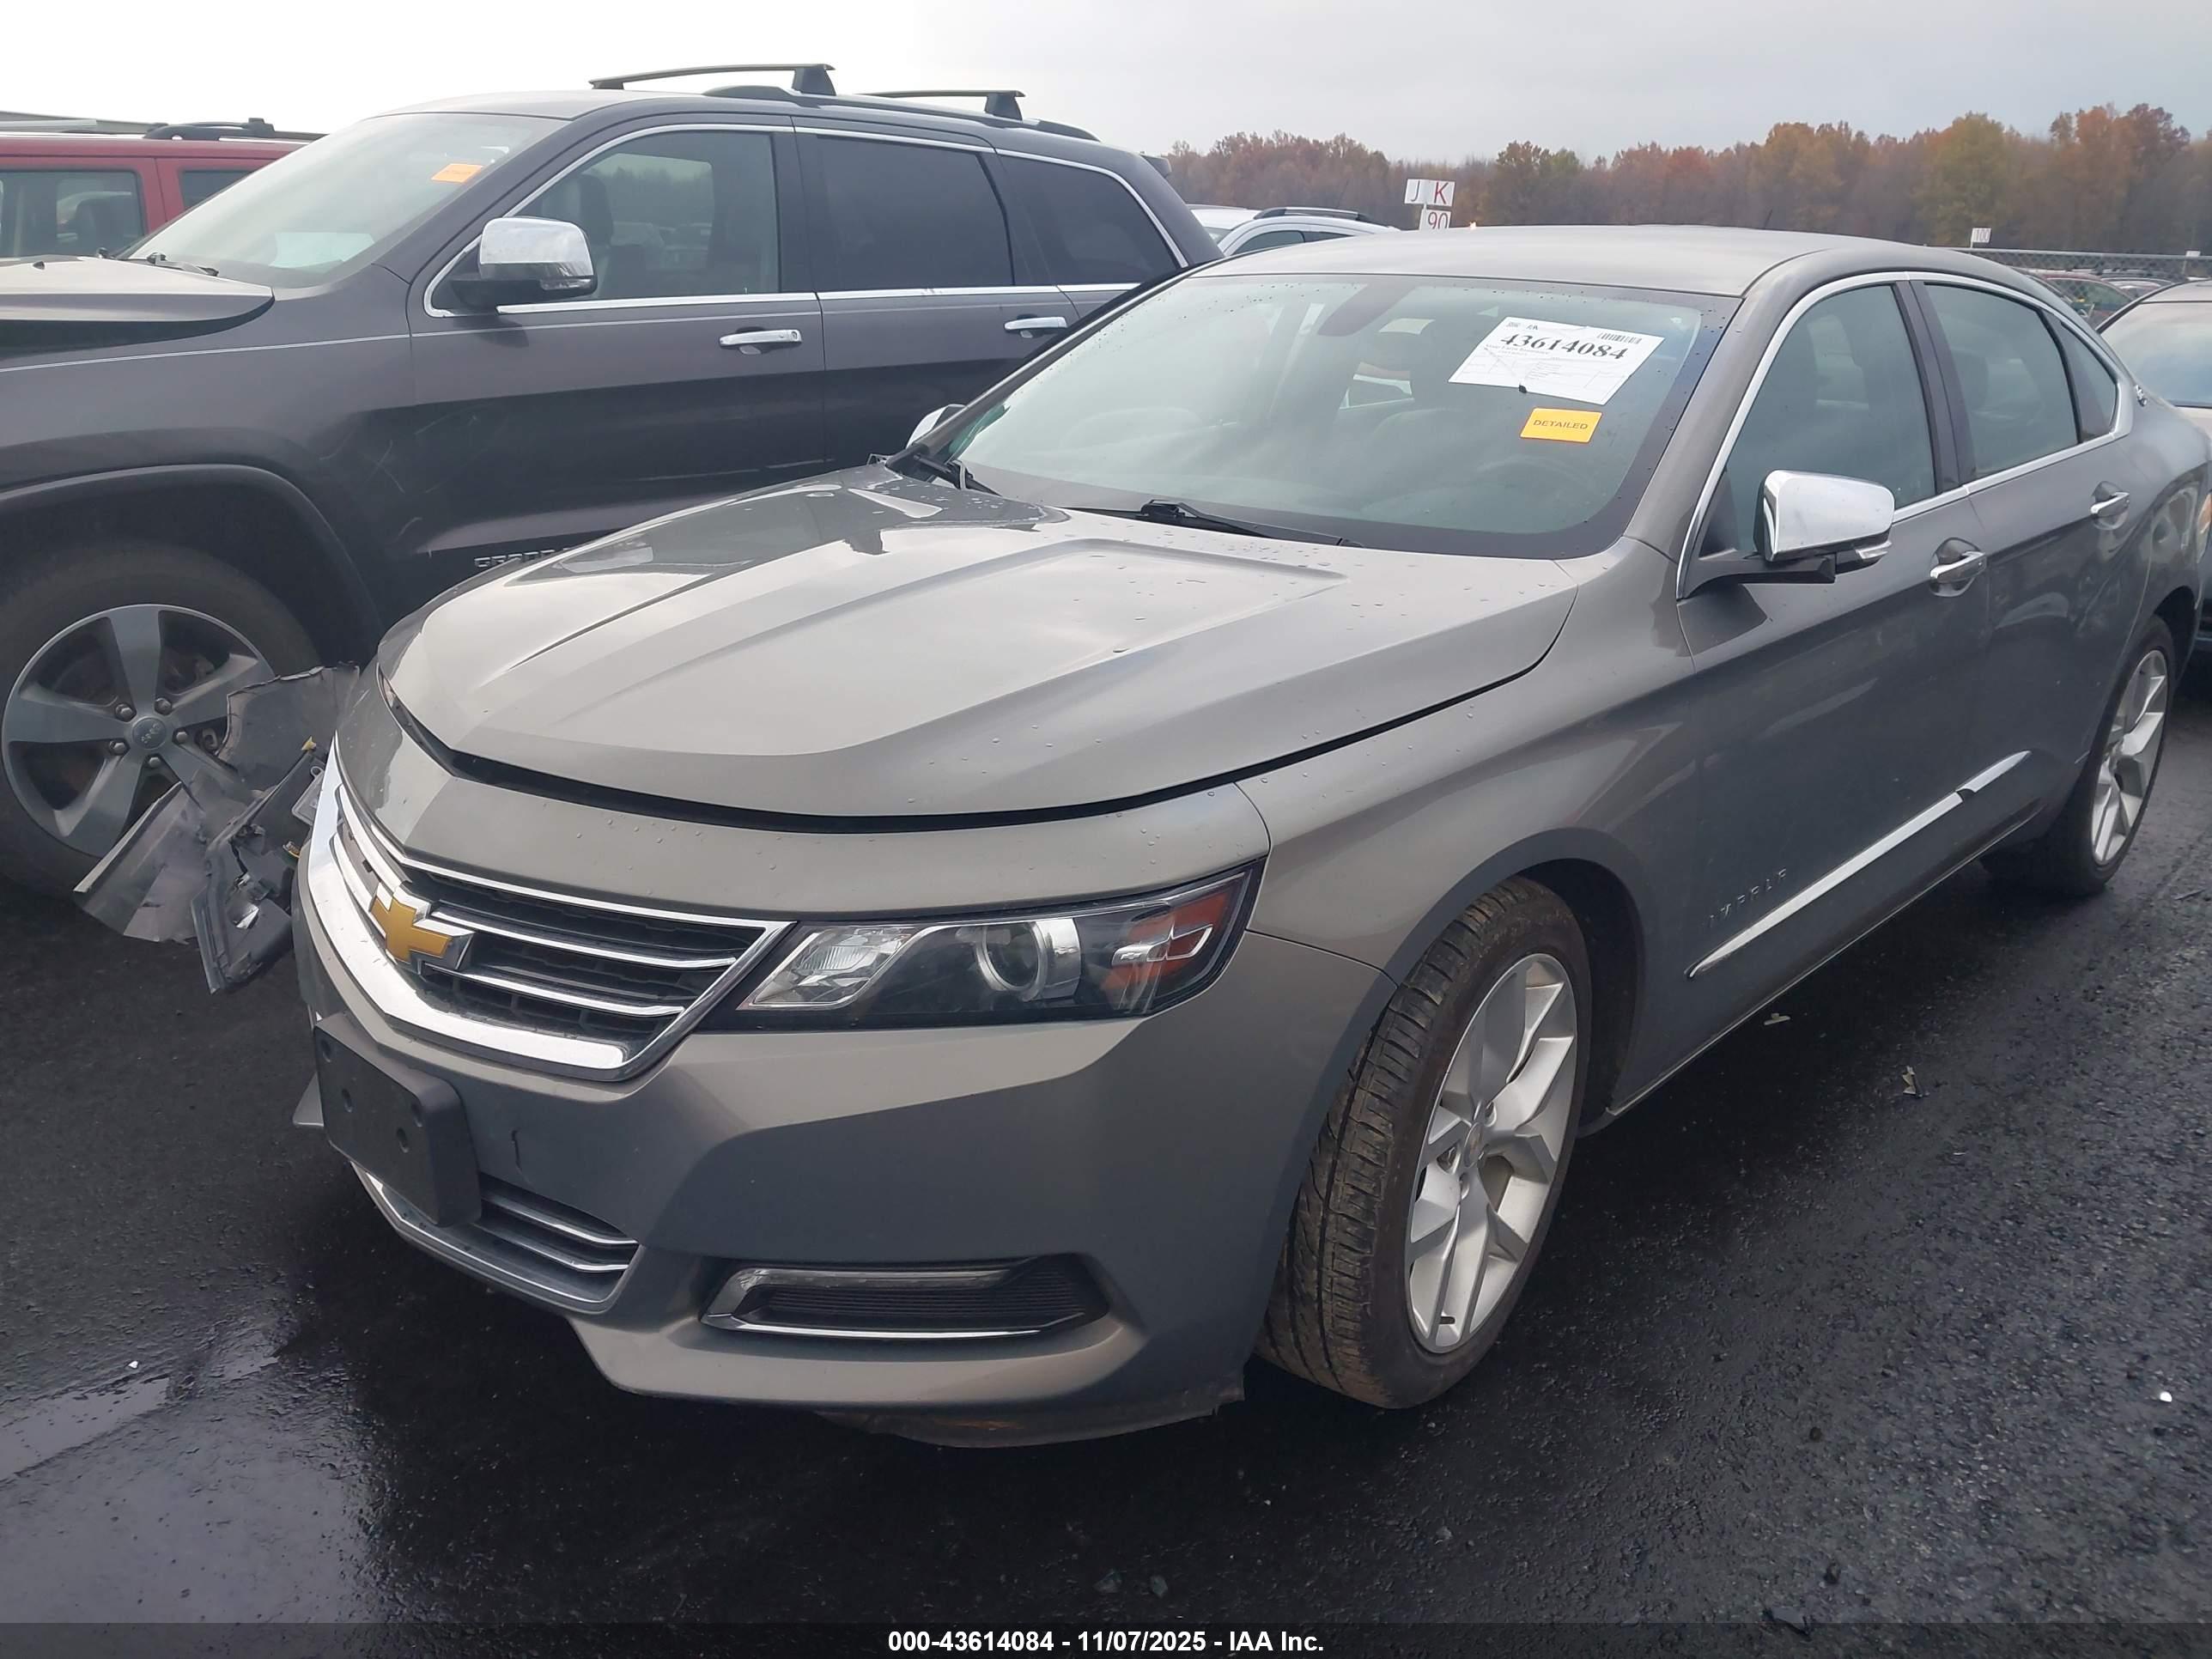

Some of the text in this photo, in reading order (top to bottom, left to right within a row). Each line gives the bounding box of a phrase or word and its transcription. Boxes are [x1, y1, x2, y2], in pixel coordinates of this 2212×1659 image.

[1410, 180, 1449, 204] J K
[1427, 211, 1449, 229] 90
[1500, 333, 1628, 360] 43614084
[1533, 419, 1589, 429] DETAILED
